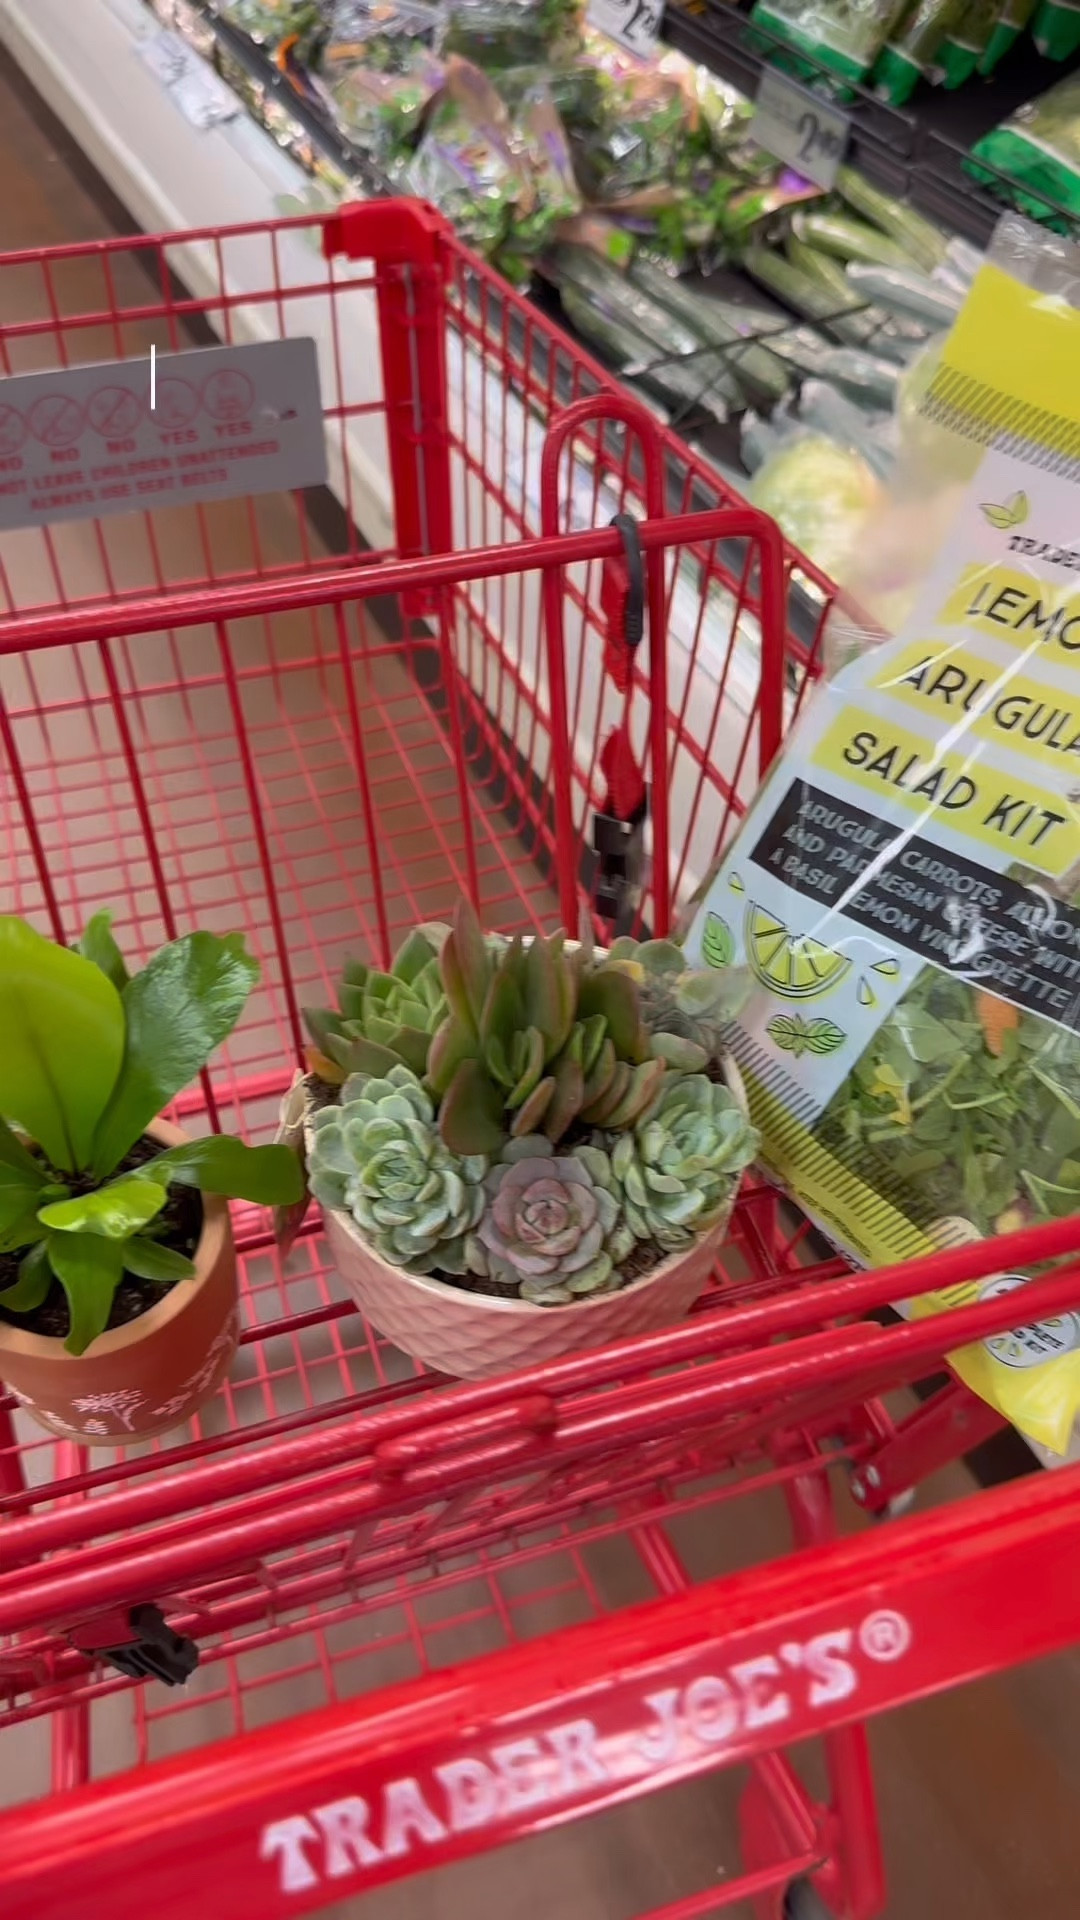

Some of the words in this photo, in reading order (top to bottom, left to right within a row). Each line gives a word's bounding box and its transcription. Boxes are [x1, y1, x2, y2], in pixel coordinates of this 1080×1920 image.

[50, 448, 79, 462] NO
[106, 438, 136, 454] NO
[160, 429, 198, 445] YES
[214, 420, 251, 438] YES
[842, 731, 978, 810] SALAD
[782, 824, 826, 853] AND
[983, 793, 1067, 846] KIT
[768, 847, 785, 866] A
[781, 855, 839, 895] BASIL
[847, 889, 920, 934] EMON
[259, 1717, 608, 1892] TRADER
